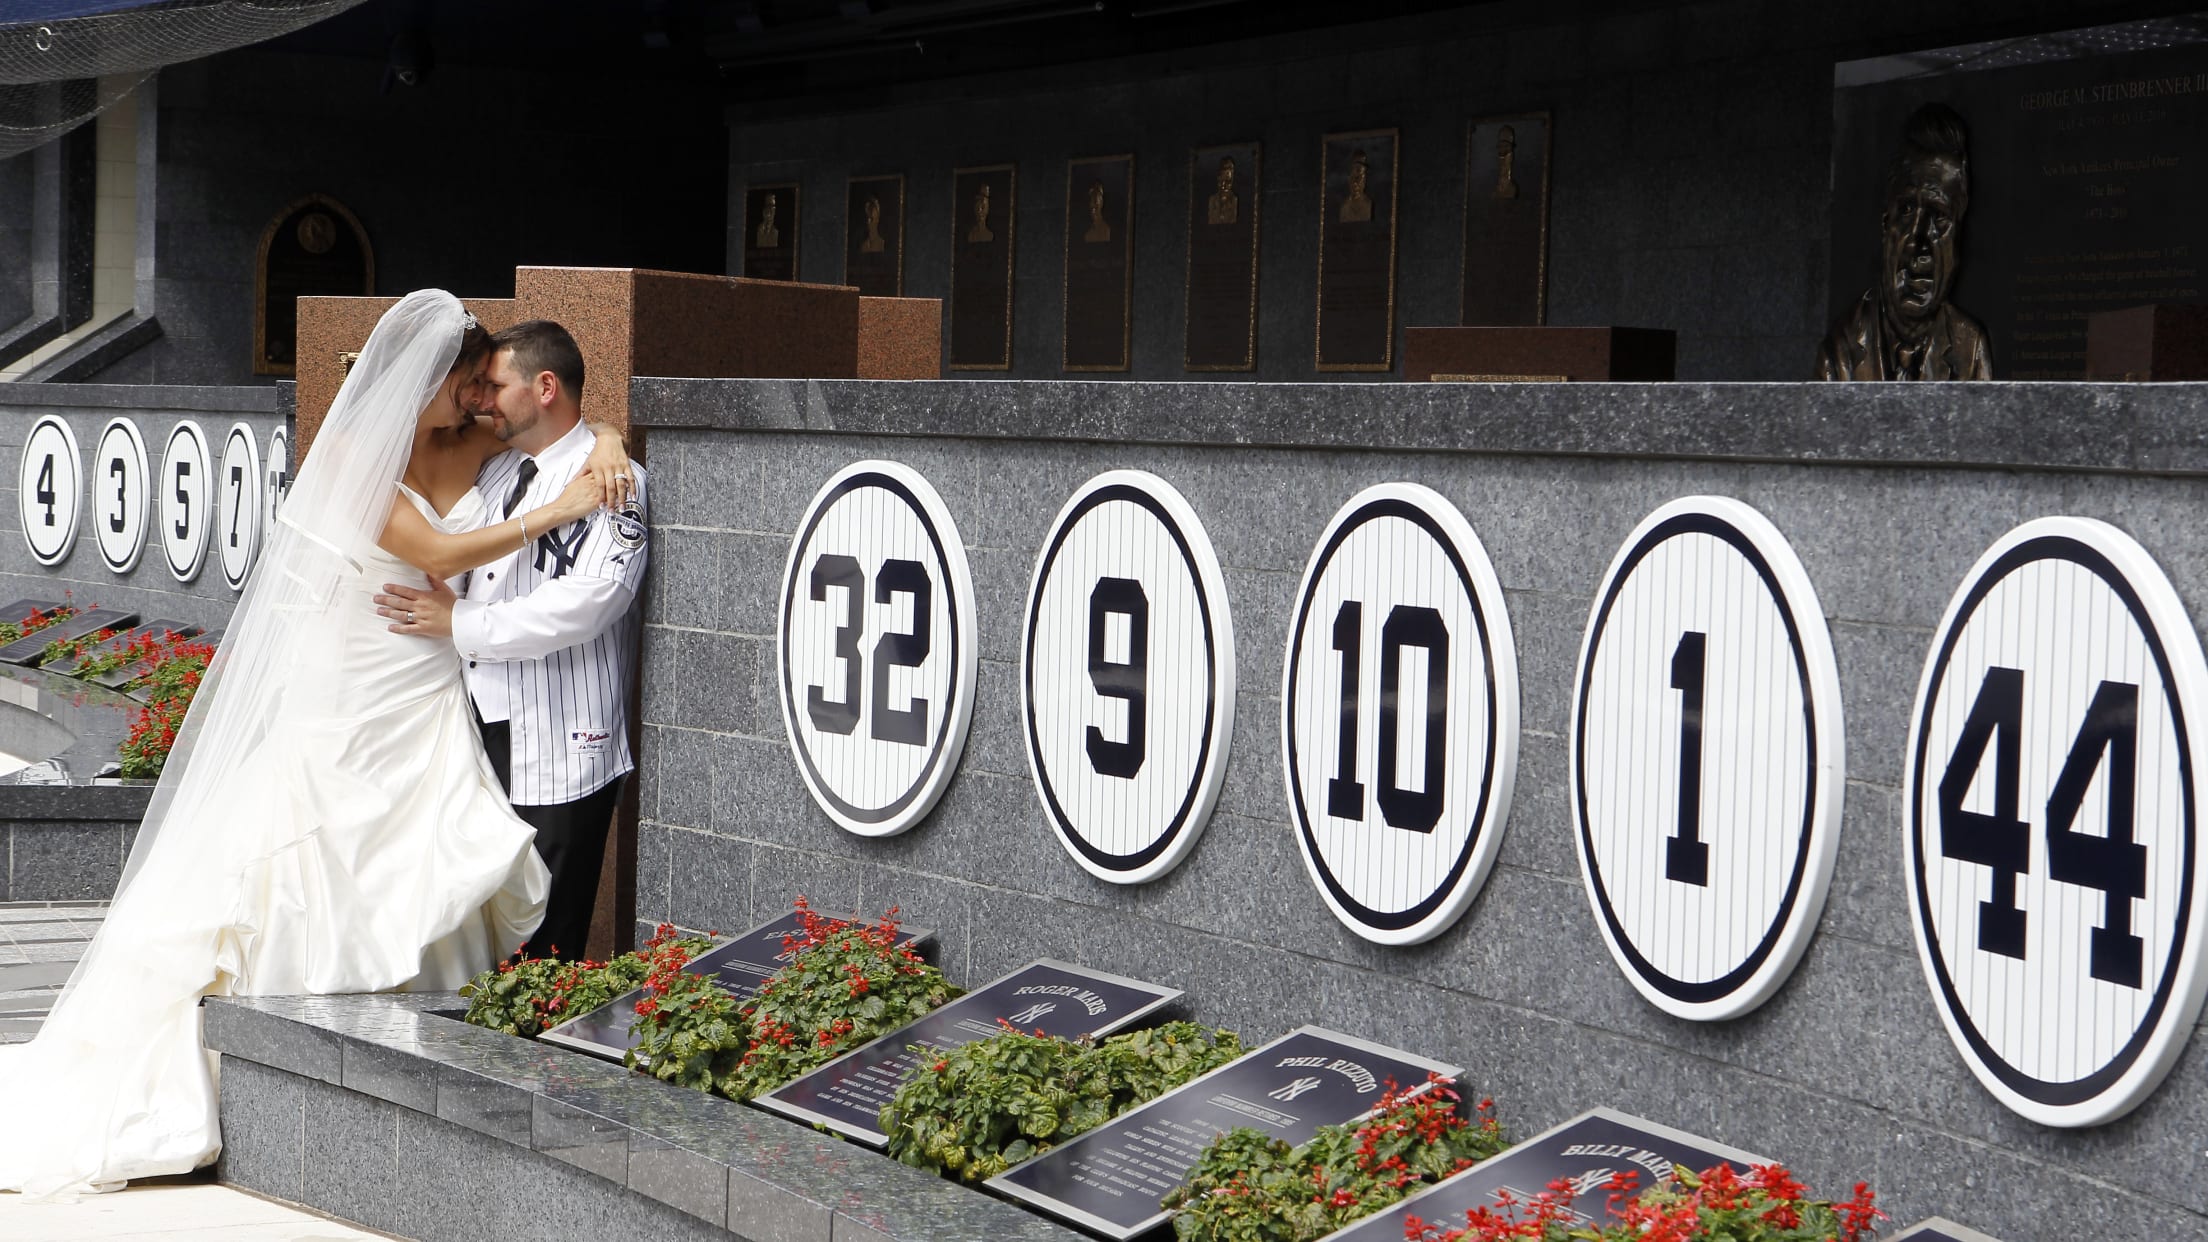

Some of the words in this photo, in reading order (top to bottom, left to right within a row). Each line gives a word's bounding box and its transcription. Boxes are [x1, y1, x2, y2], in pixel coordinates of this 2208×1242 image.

[2019, 89, 2070, 112] GEORGE
[2091, 75, 2192, 103] STEINBRENNER
[36, 454, 55, 526] 4
[110, 457, 126, 533] 3
[175, 461, 190, 540] 5
[230, 466, 243, 548] 7
[808, 554, 932, 747] 32
[1086, 577, 1149, 780] 9
[1328, 600, 1450, 835] 10
[1666, 631, 1709, 888] 1
[1939, 666, 2148, 990] 44
[1012, 985, 1080, 997] ROGER
[1072, 990, 1108, 1016] MARIS
[1275, 1056, 1329, 1068] PHIL
[1325, 1059, 1378, 1094] RIZZUTO
[1560, 1144, 1638, 1158] BILLY
